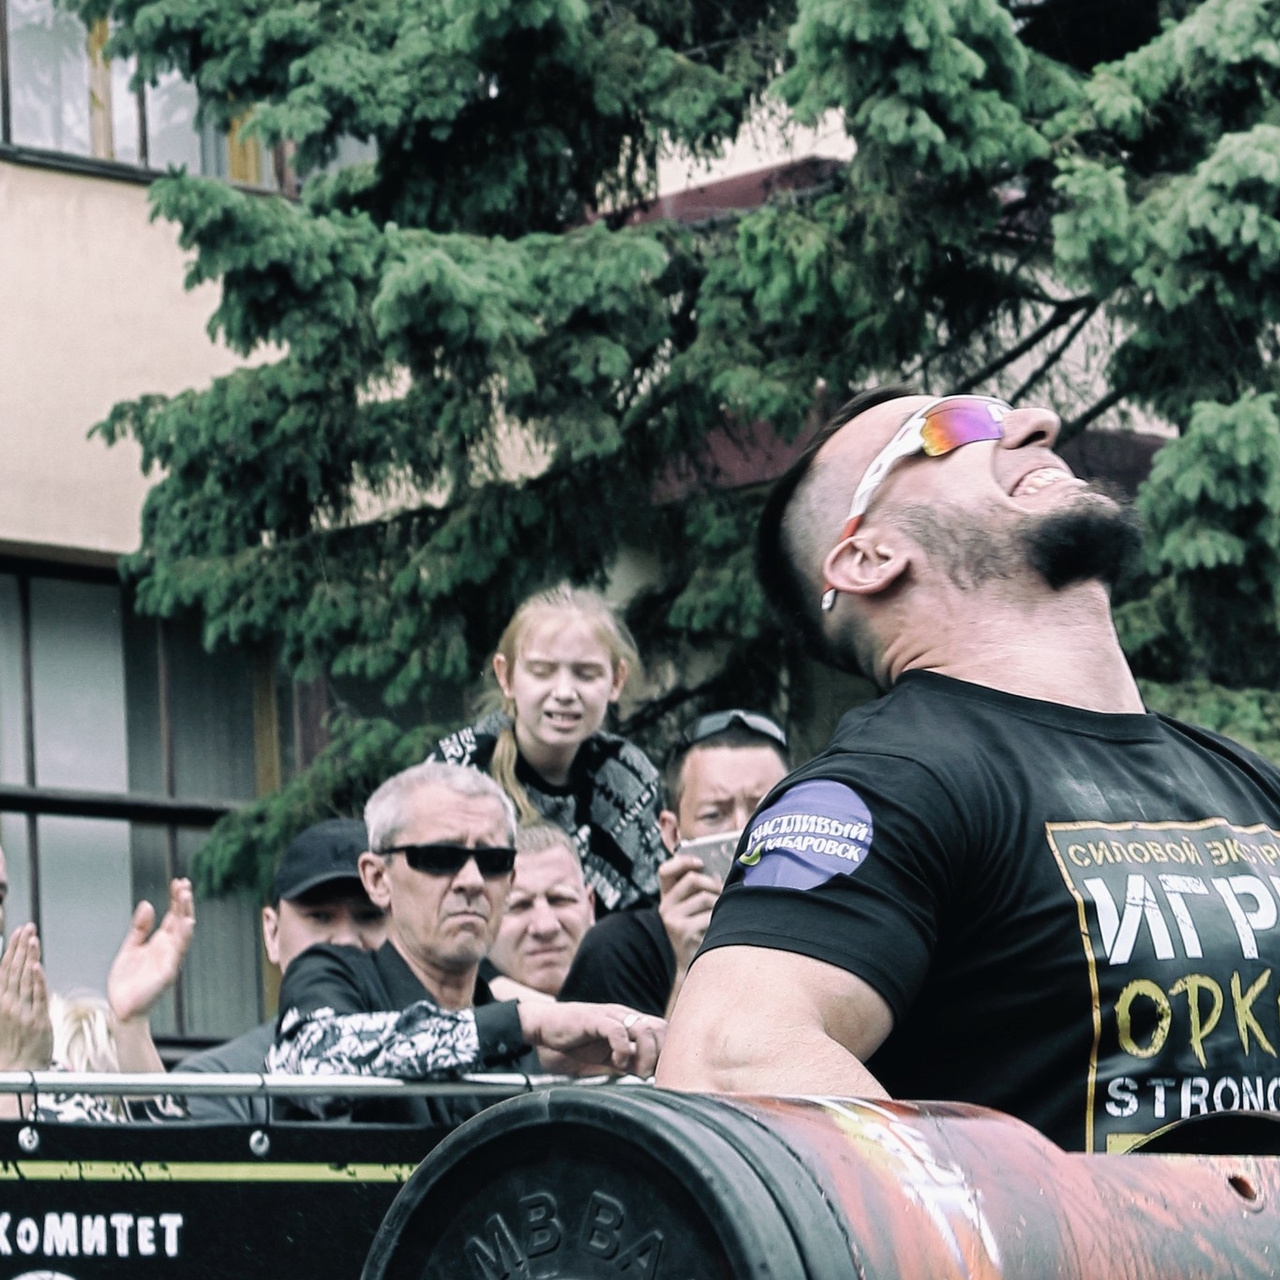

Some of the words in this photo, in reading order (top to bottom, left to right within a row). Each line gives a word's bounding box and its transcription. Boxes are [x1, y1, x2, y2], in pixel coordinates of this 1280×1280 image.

[746, 813, 869, 852] СЧАСТЛИВЫЙ
[763, 835, 863, 863] ХАБАРОВСК
[1067, 835, 1204, 867] СИЛОВОЙ
